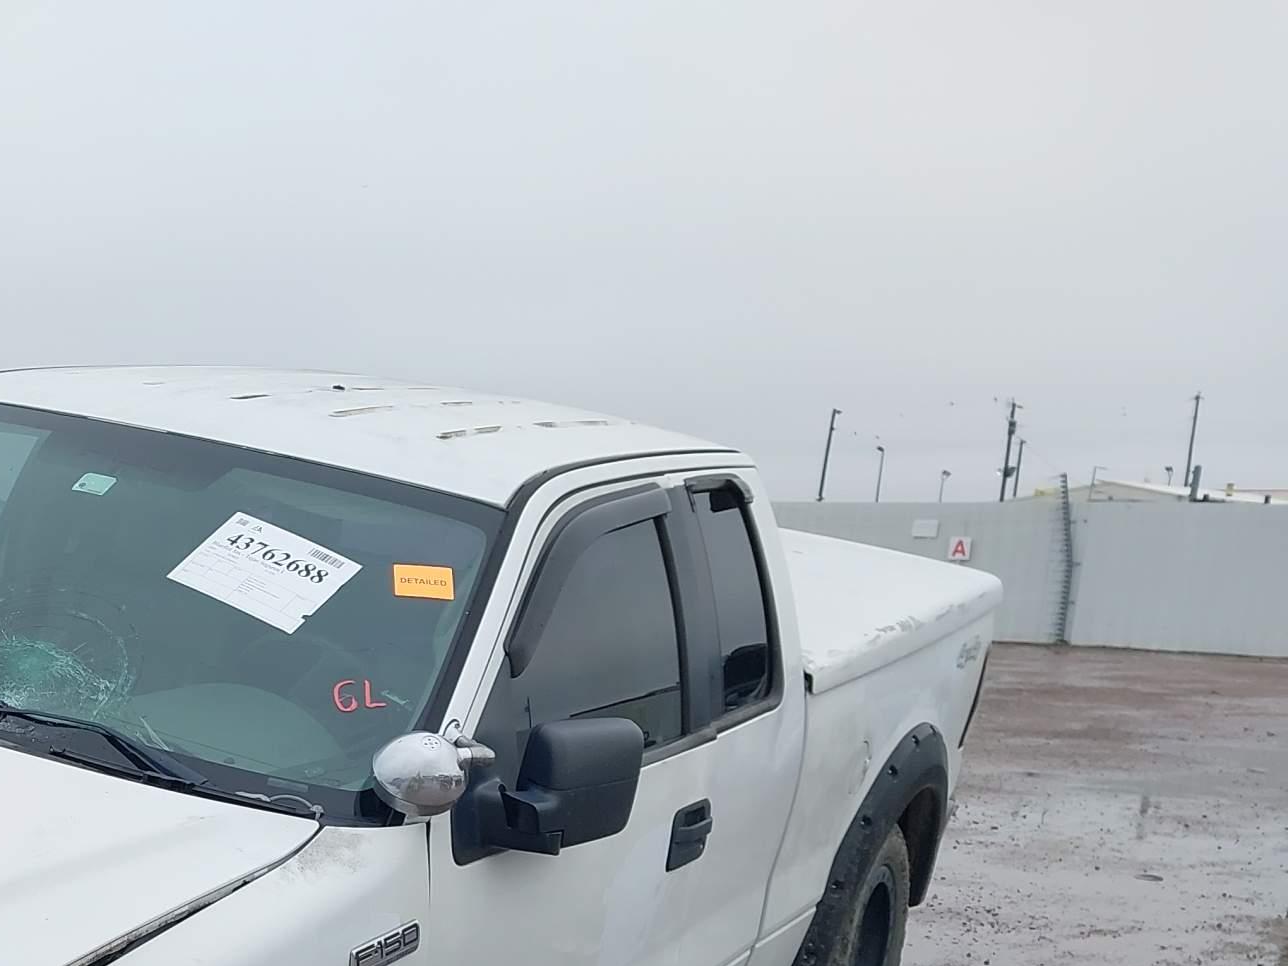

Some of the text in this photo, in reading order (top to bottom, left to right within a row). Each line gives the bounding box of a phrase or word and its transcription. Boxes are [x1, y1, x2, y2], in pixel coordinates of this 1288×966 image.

[952, 540, 966, 557] A
[226, 533, 329, 584] 43762688
[400, 577, 447, 587] DETAILED
